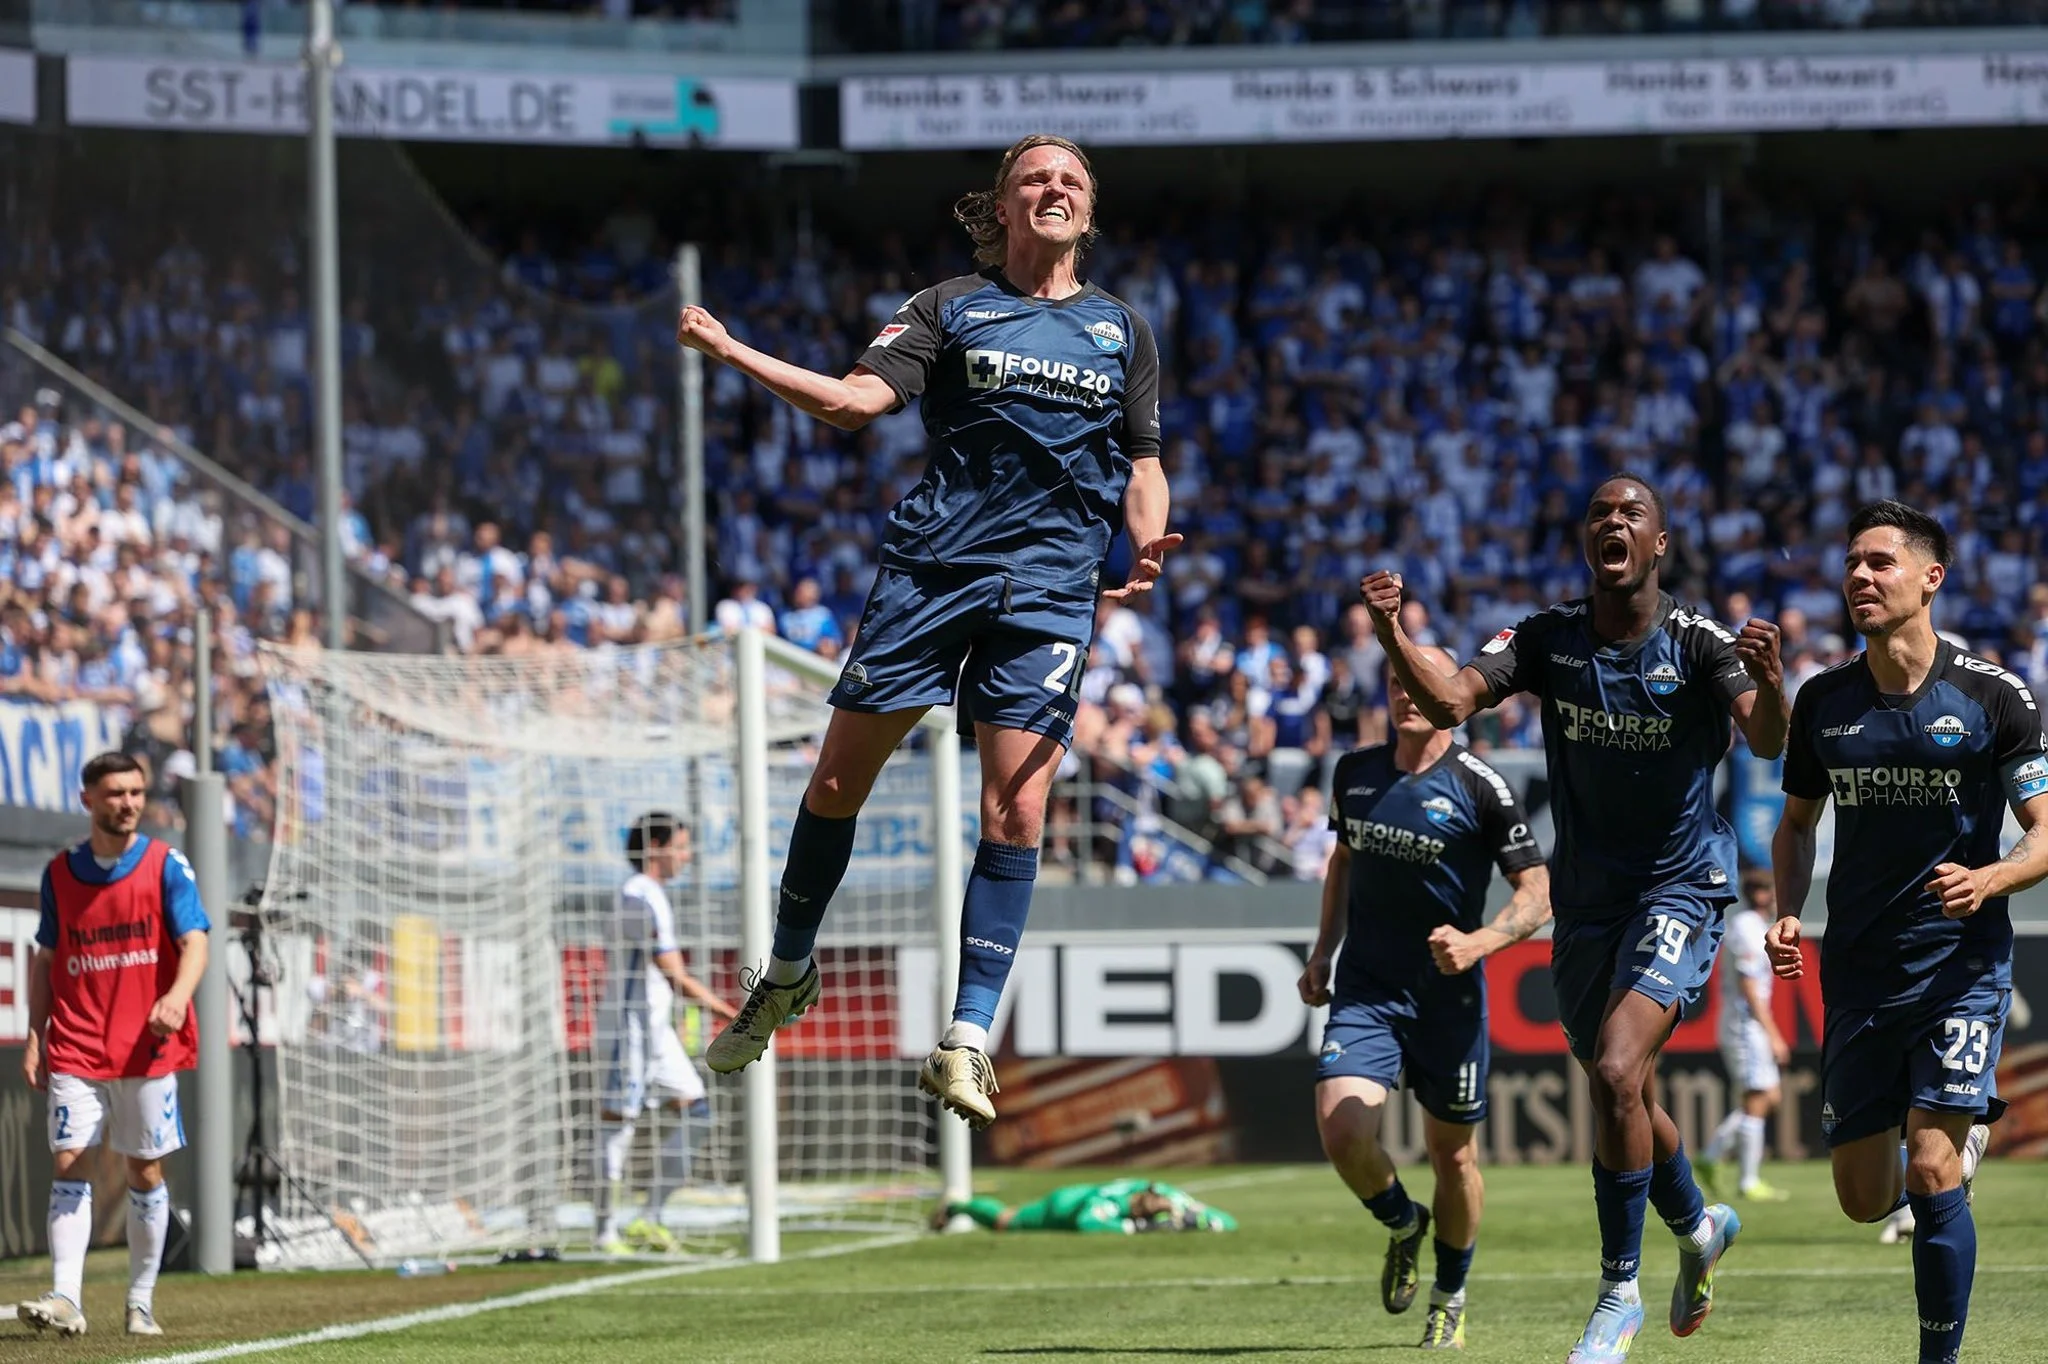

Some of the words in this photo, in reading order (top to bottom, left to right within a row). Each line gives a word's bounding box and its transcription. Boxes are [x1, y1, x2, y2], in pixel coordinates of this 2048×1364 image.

[1004, 352, 1077, 385] FOUR
[1080, 369, 1111, 395] 20
[1002, 371, 1104, 409] PHARMA
[1551, 653, 1588, 668] saller
[1580, 707, 1640, 733] FOUR
[1644, 716, 1673, 735] 20
[1822, 724, 1865, 738] saller
[1579, 725, 1672, 751] PHARMA
[1857, 767, 1925, 787] FOUR
[1929, 768, 1962, 788] 20
[1859, 787, 1961, 806] PHARMA
[1362, 820, 1415, 847] FOUR
[1416, 834, 1445, 854] 20
[1635, 913, 1691, 965] 29
[1632, 965, 1674, 986] saller
[1941, 1017, 1990, 1074] 23
[1458, 1061, 1477, 1102] 11
[1944, 1082, 1981, 1096] saller
[54, 1105, 73, 1141] 2
